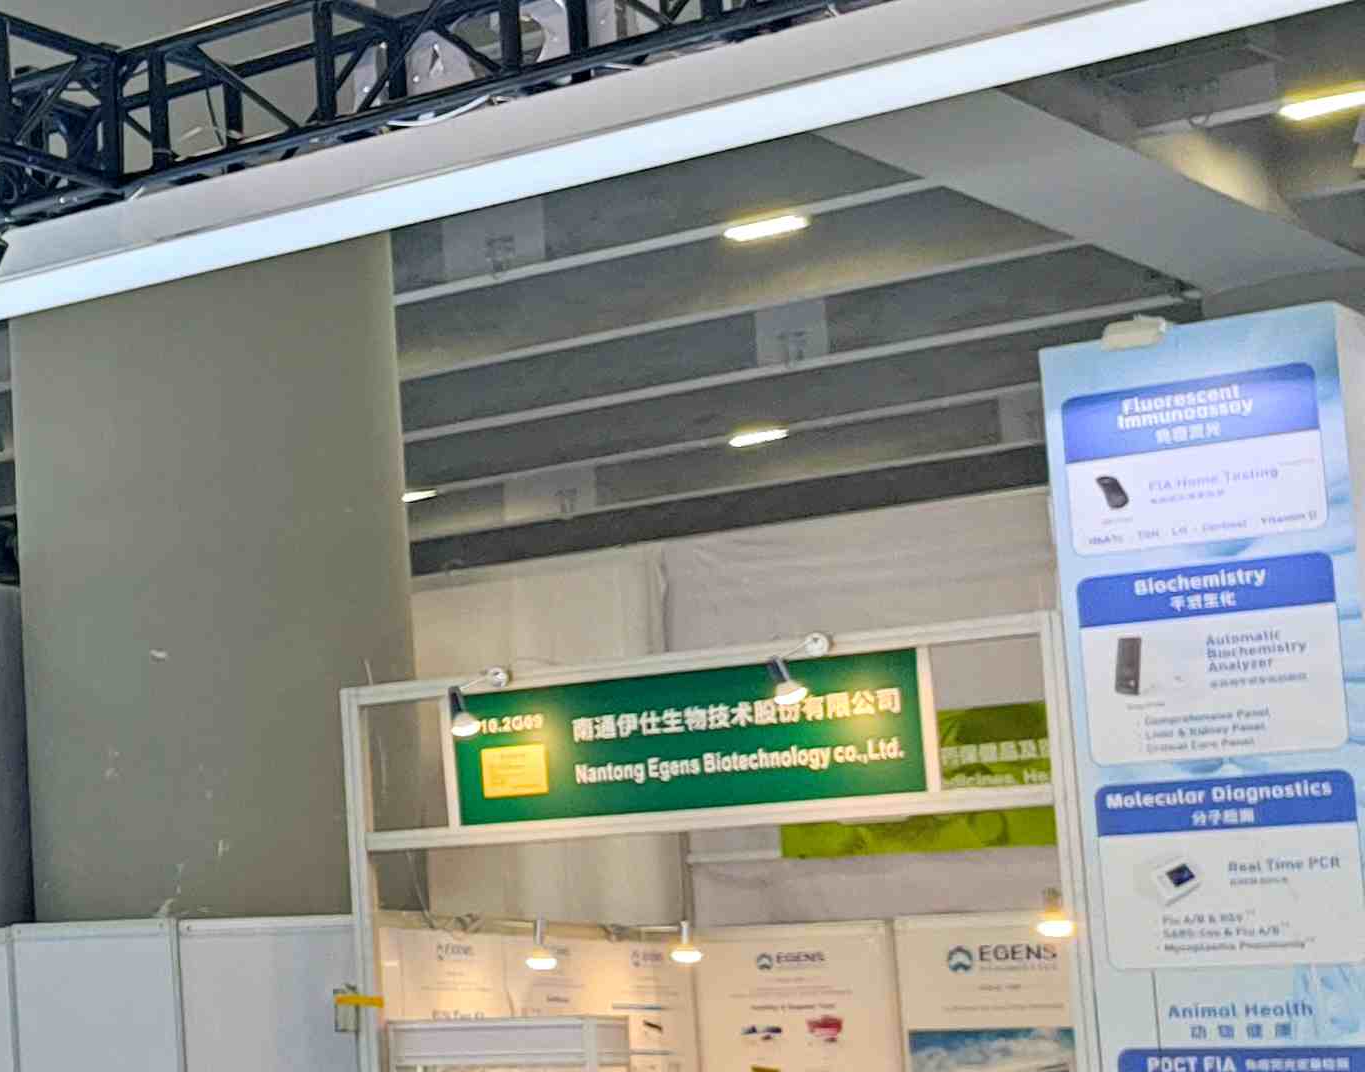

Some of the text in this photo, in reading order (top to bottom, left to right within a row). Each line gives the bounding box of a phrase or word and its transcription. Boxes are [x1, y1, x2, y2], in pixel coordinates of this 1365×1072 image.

[1122, 385, 1240, 415] Fluorescent
[1117, 400, 1254, 430] Immunoassay
[1134, 568, 1267, 596] Biochemistry
[1206, 630, 1281, 646] Automatic
[1207, 641, 1307, 660] Biochemistry
[1209, 657, 1273, 673] Analyzer
[572, 687, 902, 743] 南通伊仕生物技术股份有限公司
[575, 762, 645, 786] Nantong
[648, 757, 700, 784] Egens
[703, 745, 830, 774] Biotechnology
[1106, 779, 1333, 810] Molecular Diagnostics
[1228, 855, 1341, 873] Real Time PCR
[979, 943, 1058, 962] EGENS
[1169, 1000, 1313, 1019] Animal Health
